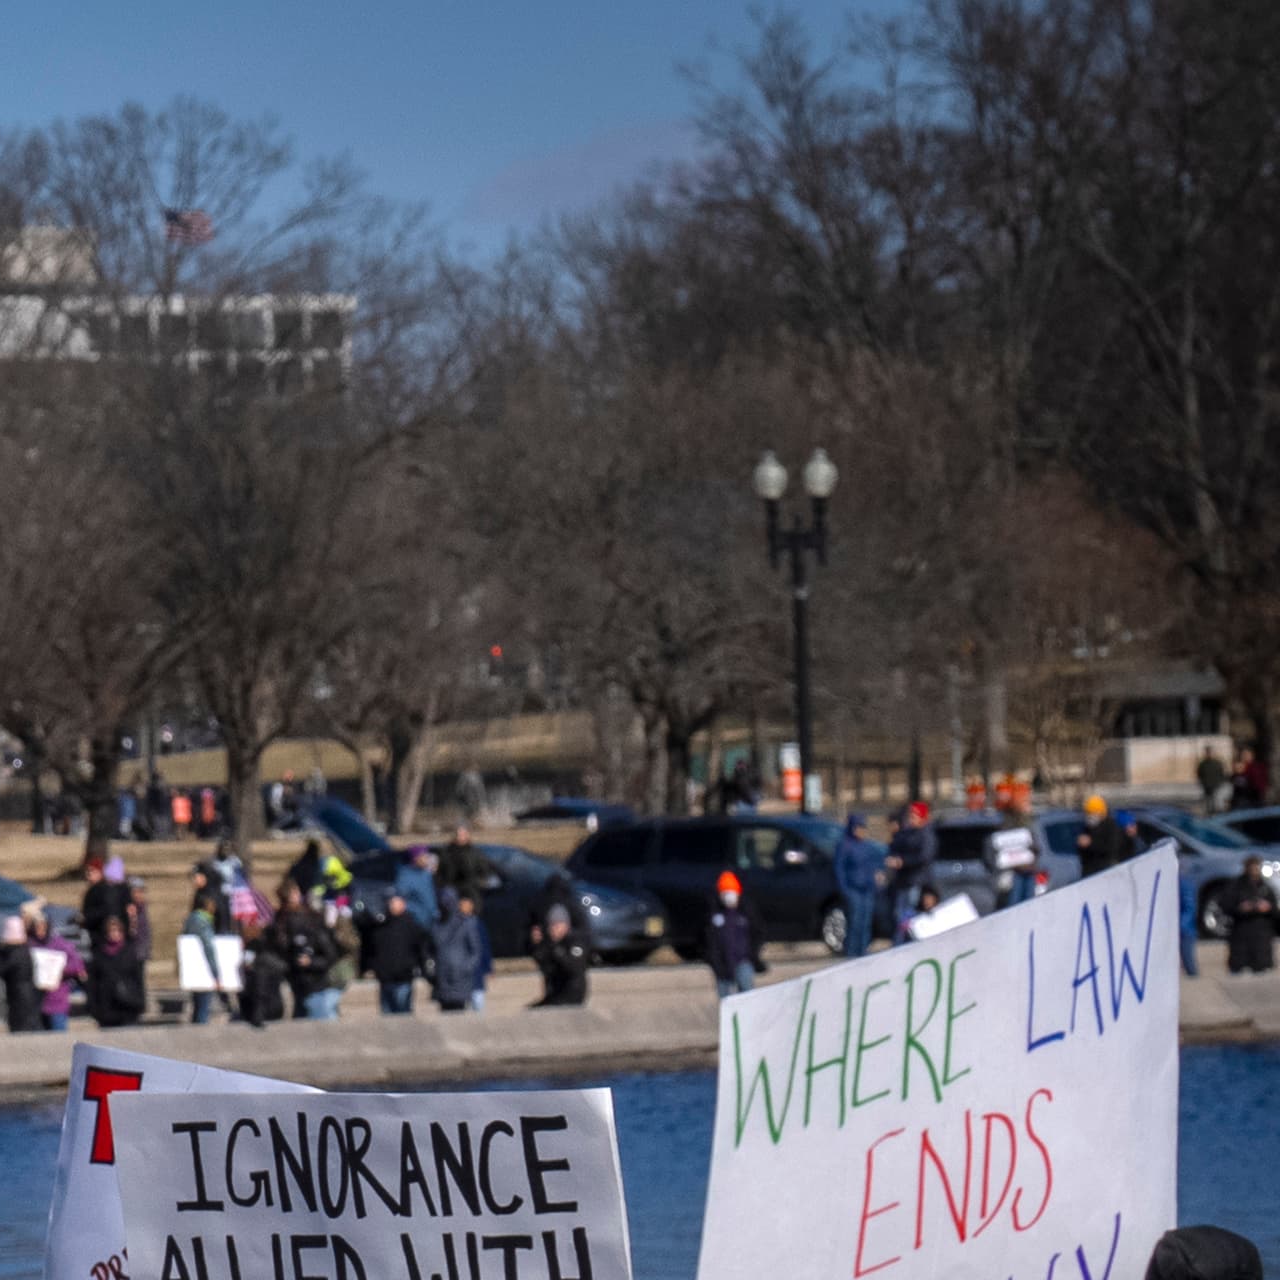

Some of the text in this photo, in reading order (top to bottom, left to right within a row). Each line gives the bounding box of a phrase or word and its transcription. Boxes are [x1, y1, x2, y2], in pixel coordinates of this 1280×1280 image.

[733, 869, 1161, 1149] WHERE LAW
[172, 1111, 579, 1219] IGNORANCE
[854, 1088, 1053, 1279] ENDS
